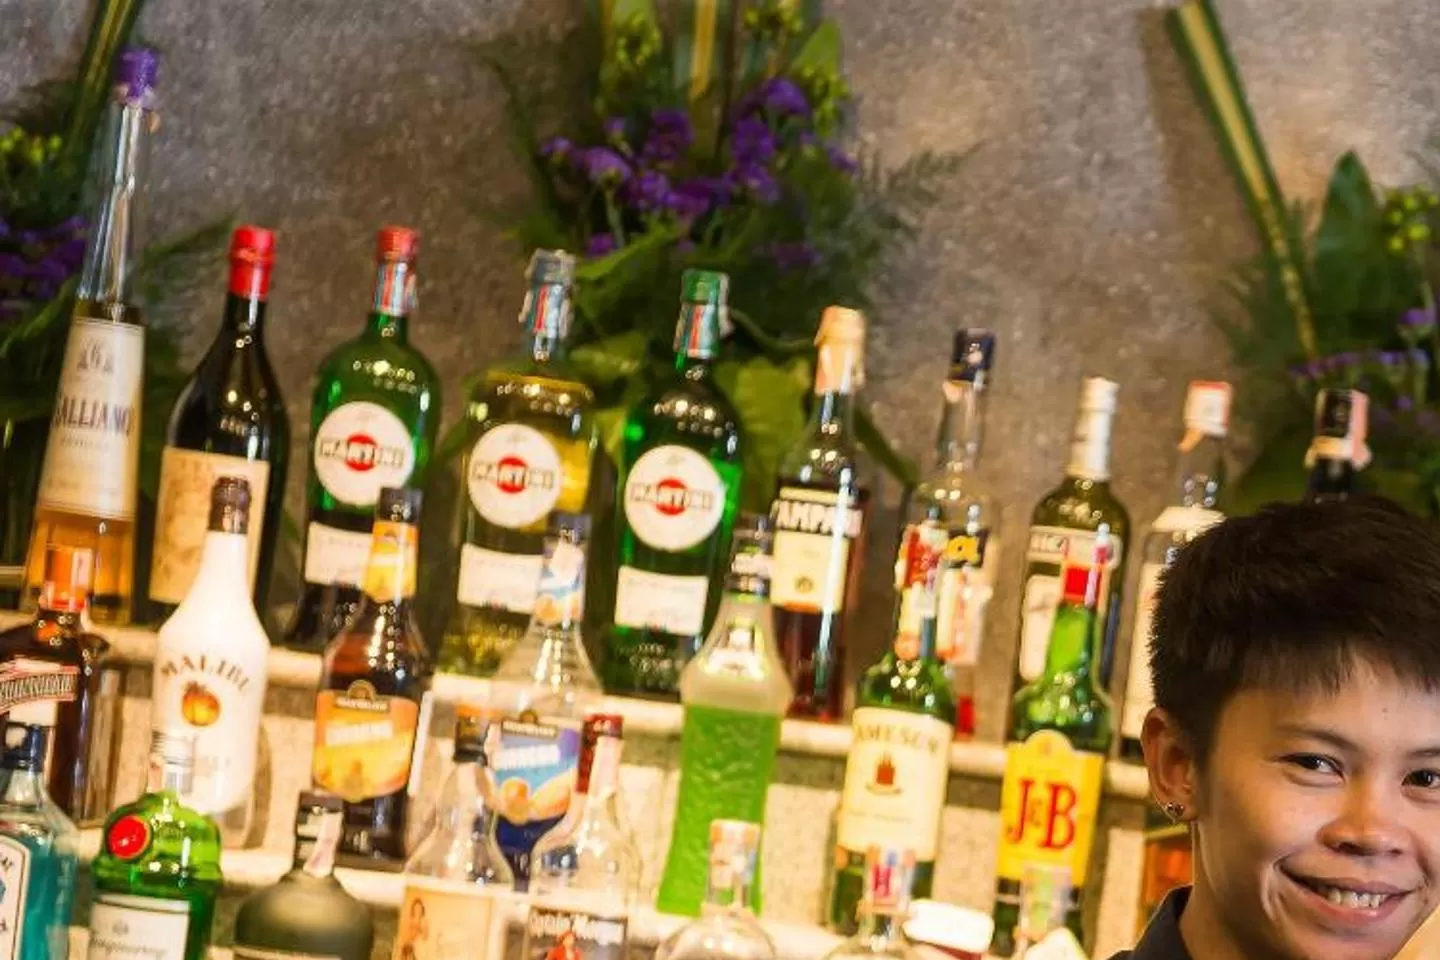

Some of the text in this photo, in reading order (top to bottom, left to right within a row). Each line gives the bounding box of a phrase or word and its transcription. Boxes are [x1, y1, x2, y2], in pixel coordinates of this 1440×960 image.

[769, 499, 864, 538] AMPA
[854, 723, 939, 756] AMESON
[1006, 777, 1077, 851] J&B
